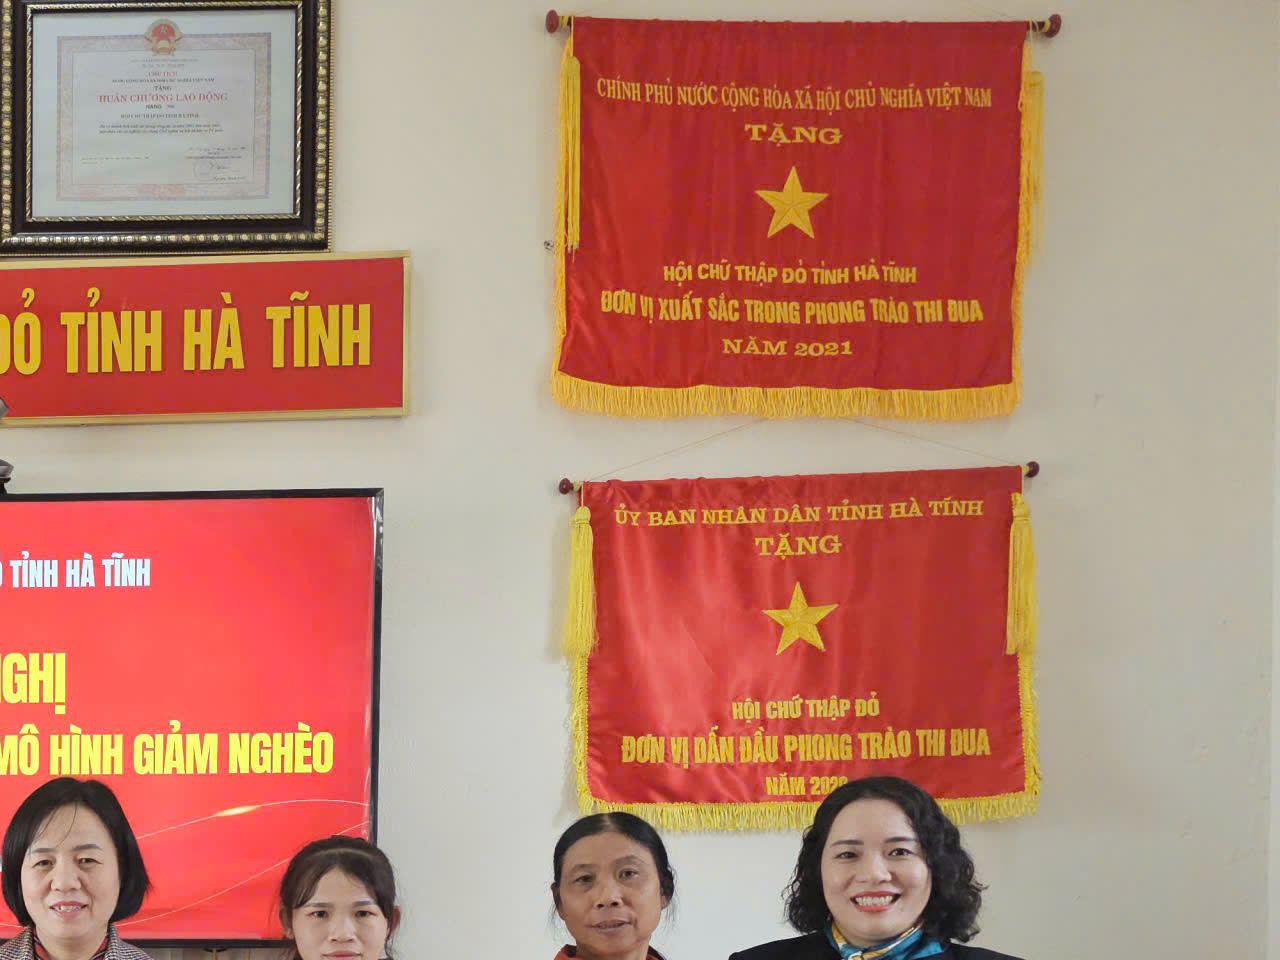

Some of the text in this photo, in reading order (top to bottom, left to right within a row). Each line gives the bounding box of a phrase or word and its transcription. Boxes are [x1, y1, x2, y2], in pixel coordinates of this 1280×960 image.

[965, 87, 991, 107] NAM
[744, 123, 843, 148] TẶNG
[601, 289, 984, 324] ĐƠN VỊ XUẤT SẮC TRONG PHONG TRÀO THI ĐUA
[60, 289, 162, 373] TỈNH
[183, 292, 243, 371] HÀ
[267, 292, 372, 368] TĨNH
[722, 336, 852, 355] NĂM 2021
[614, 503, 641, 526] ỦY
[648, 509, 696, 526] BAN
[702, 505, 766, 524] NHÂN
[773, 504, 820, 522] DÂN
[827, 499, 883, 521] TỈNH
[889, 498, 922, 518] HÀ
[755, 533, 842, 560] TẶNG
[10, 551, 58, 587] TỈNH
[65, 554, 97, 587] HÀ
[102, 555, 151, 587] TĨNH
[732, 692, 880, 723] HỘI CHỮ THẬP ĐỎ
[49, 725, 123, 775] HÌNH
[133, 720, 218, 774] GIẢM
[228, 722, 334, 774] NGHÈO
[622, 726, 991, 768] ĐƠN VỊ DẪN ĐẦU PHONG TRÀO THI ĐUA
[765, 773, 806, 795] NĂM
